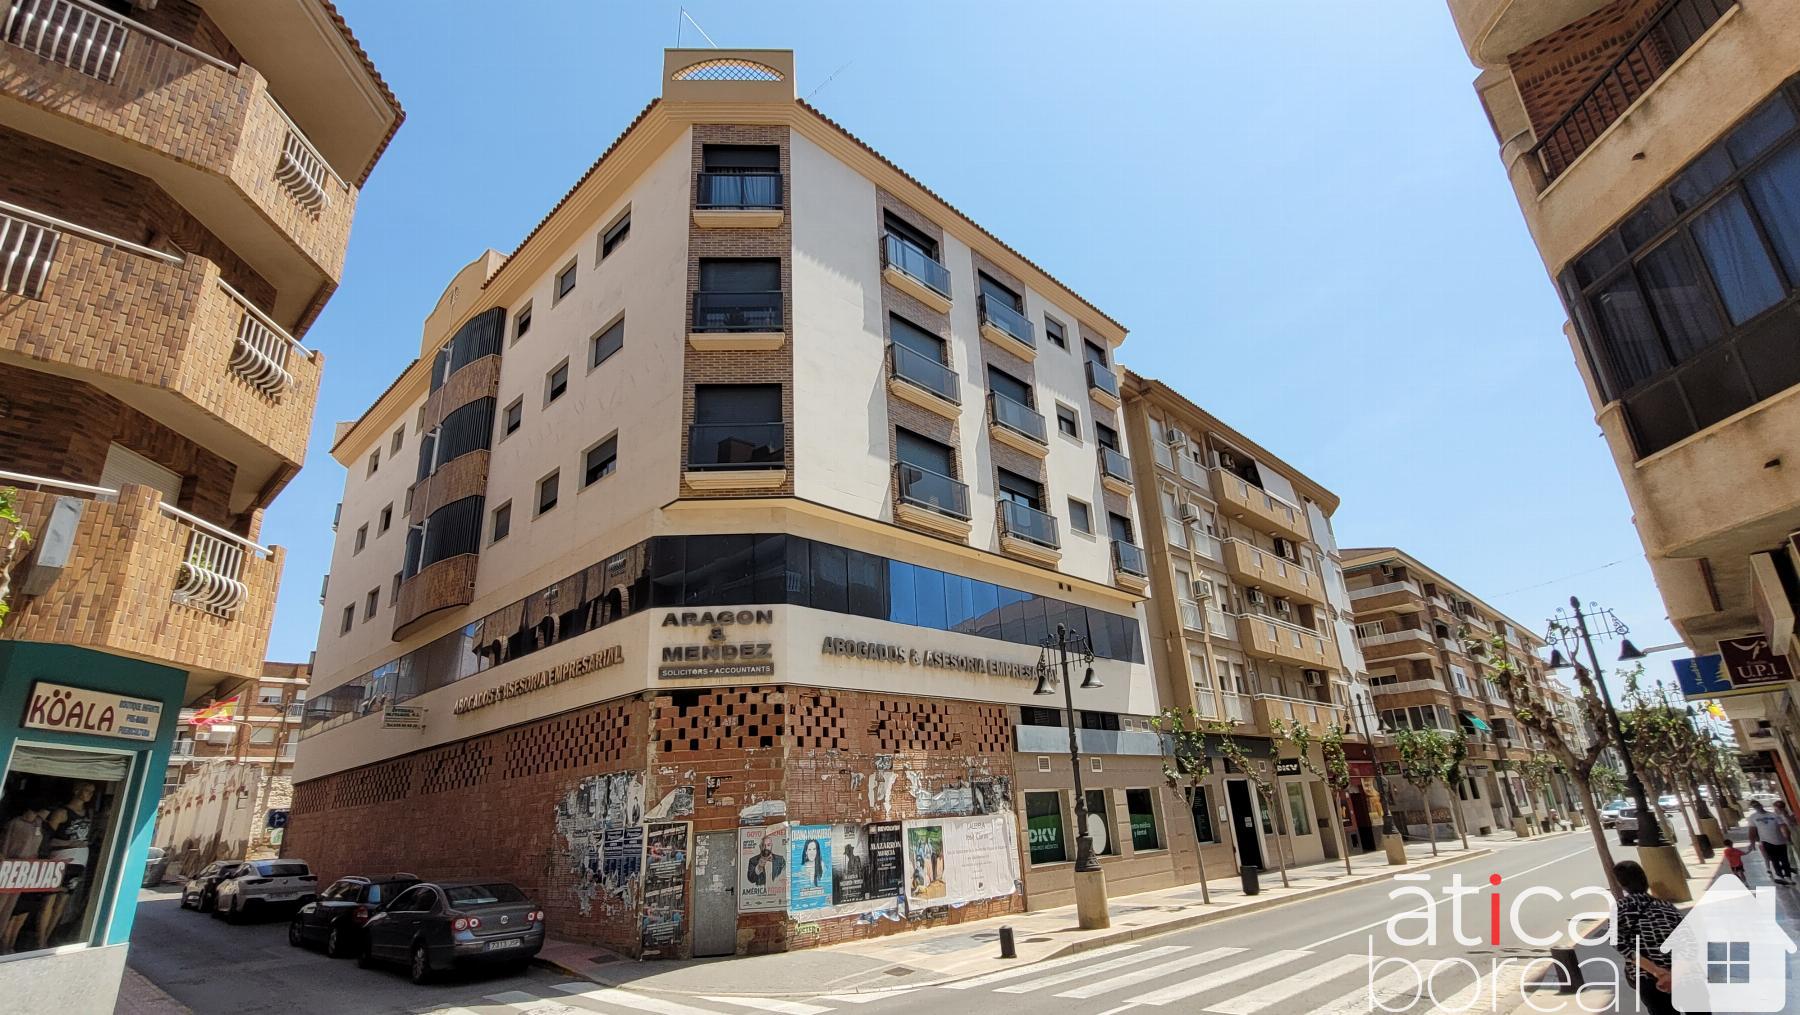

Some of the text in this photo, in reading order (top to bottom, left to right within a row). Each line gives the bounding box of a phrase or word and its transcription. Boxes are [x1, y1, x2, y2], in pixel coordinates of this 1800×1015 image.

[662, 610, 773, 627] ARAGON
[709, 627, 726, 641] &
[662, 643, 772, 662] MENDEZ
[821, 636, 1060, 684] ABOGADOS & ASESORIA EMPRESAIAL
[548, 645, 625, 684] EMPRESARIAL
[662, 666, 771, 677] SOLICITORS ACCOUNTANTS
[29, 689, 114, 732] KÖALA
[1277, 763, 1298, 772] DKV
[1029, 828, 1056, 843] DKV
[0, 861, 65, 889] REBAJAS
